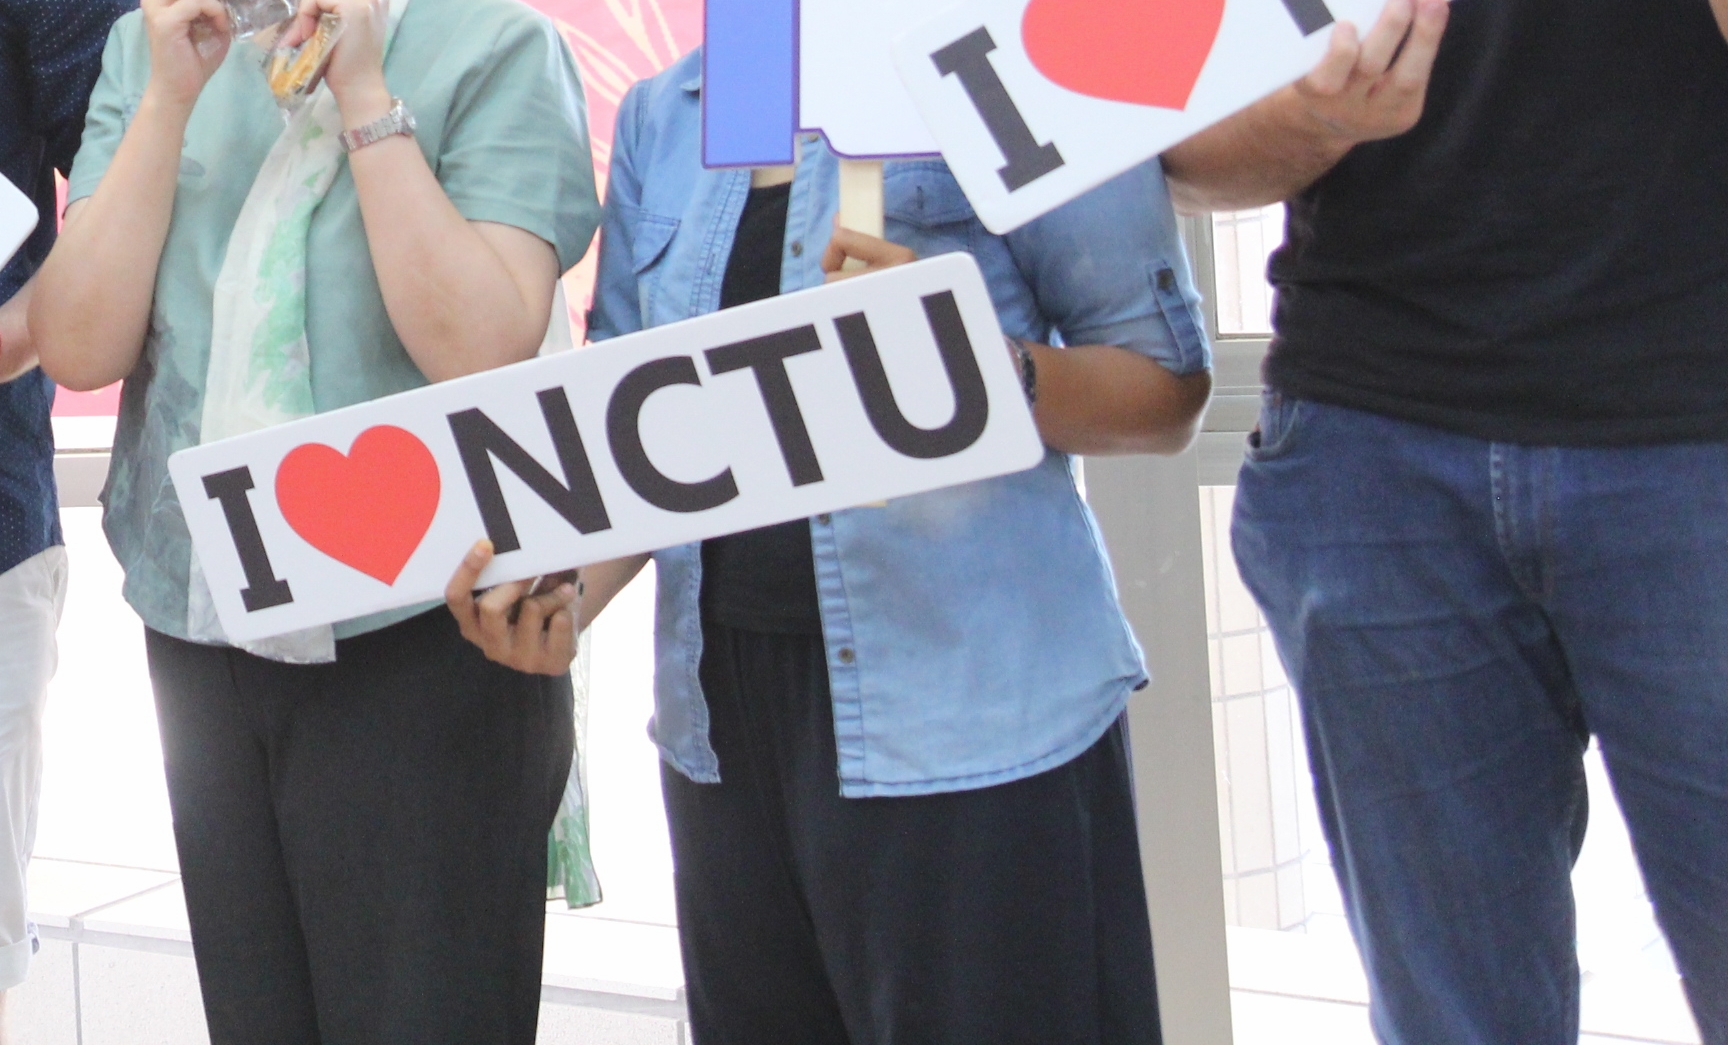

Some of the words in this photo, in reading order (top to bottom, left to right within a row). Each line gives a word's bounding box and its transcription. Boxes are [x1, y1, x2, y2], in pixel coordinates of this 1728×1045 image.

[930, 25, 1065, 193] I
[202, 465, 294, 613] I
[446, 289, 990, 555] NCTU
